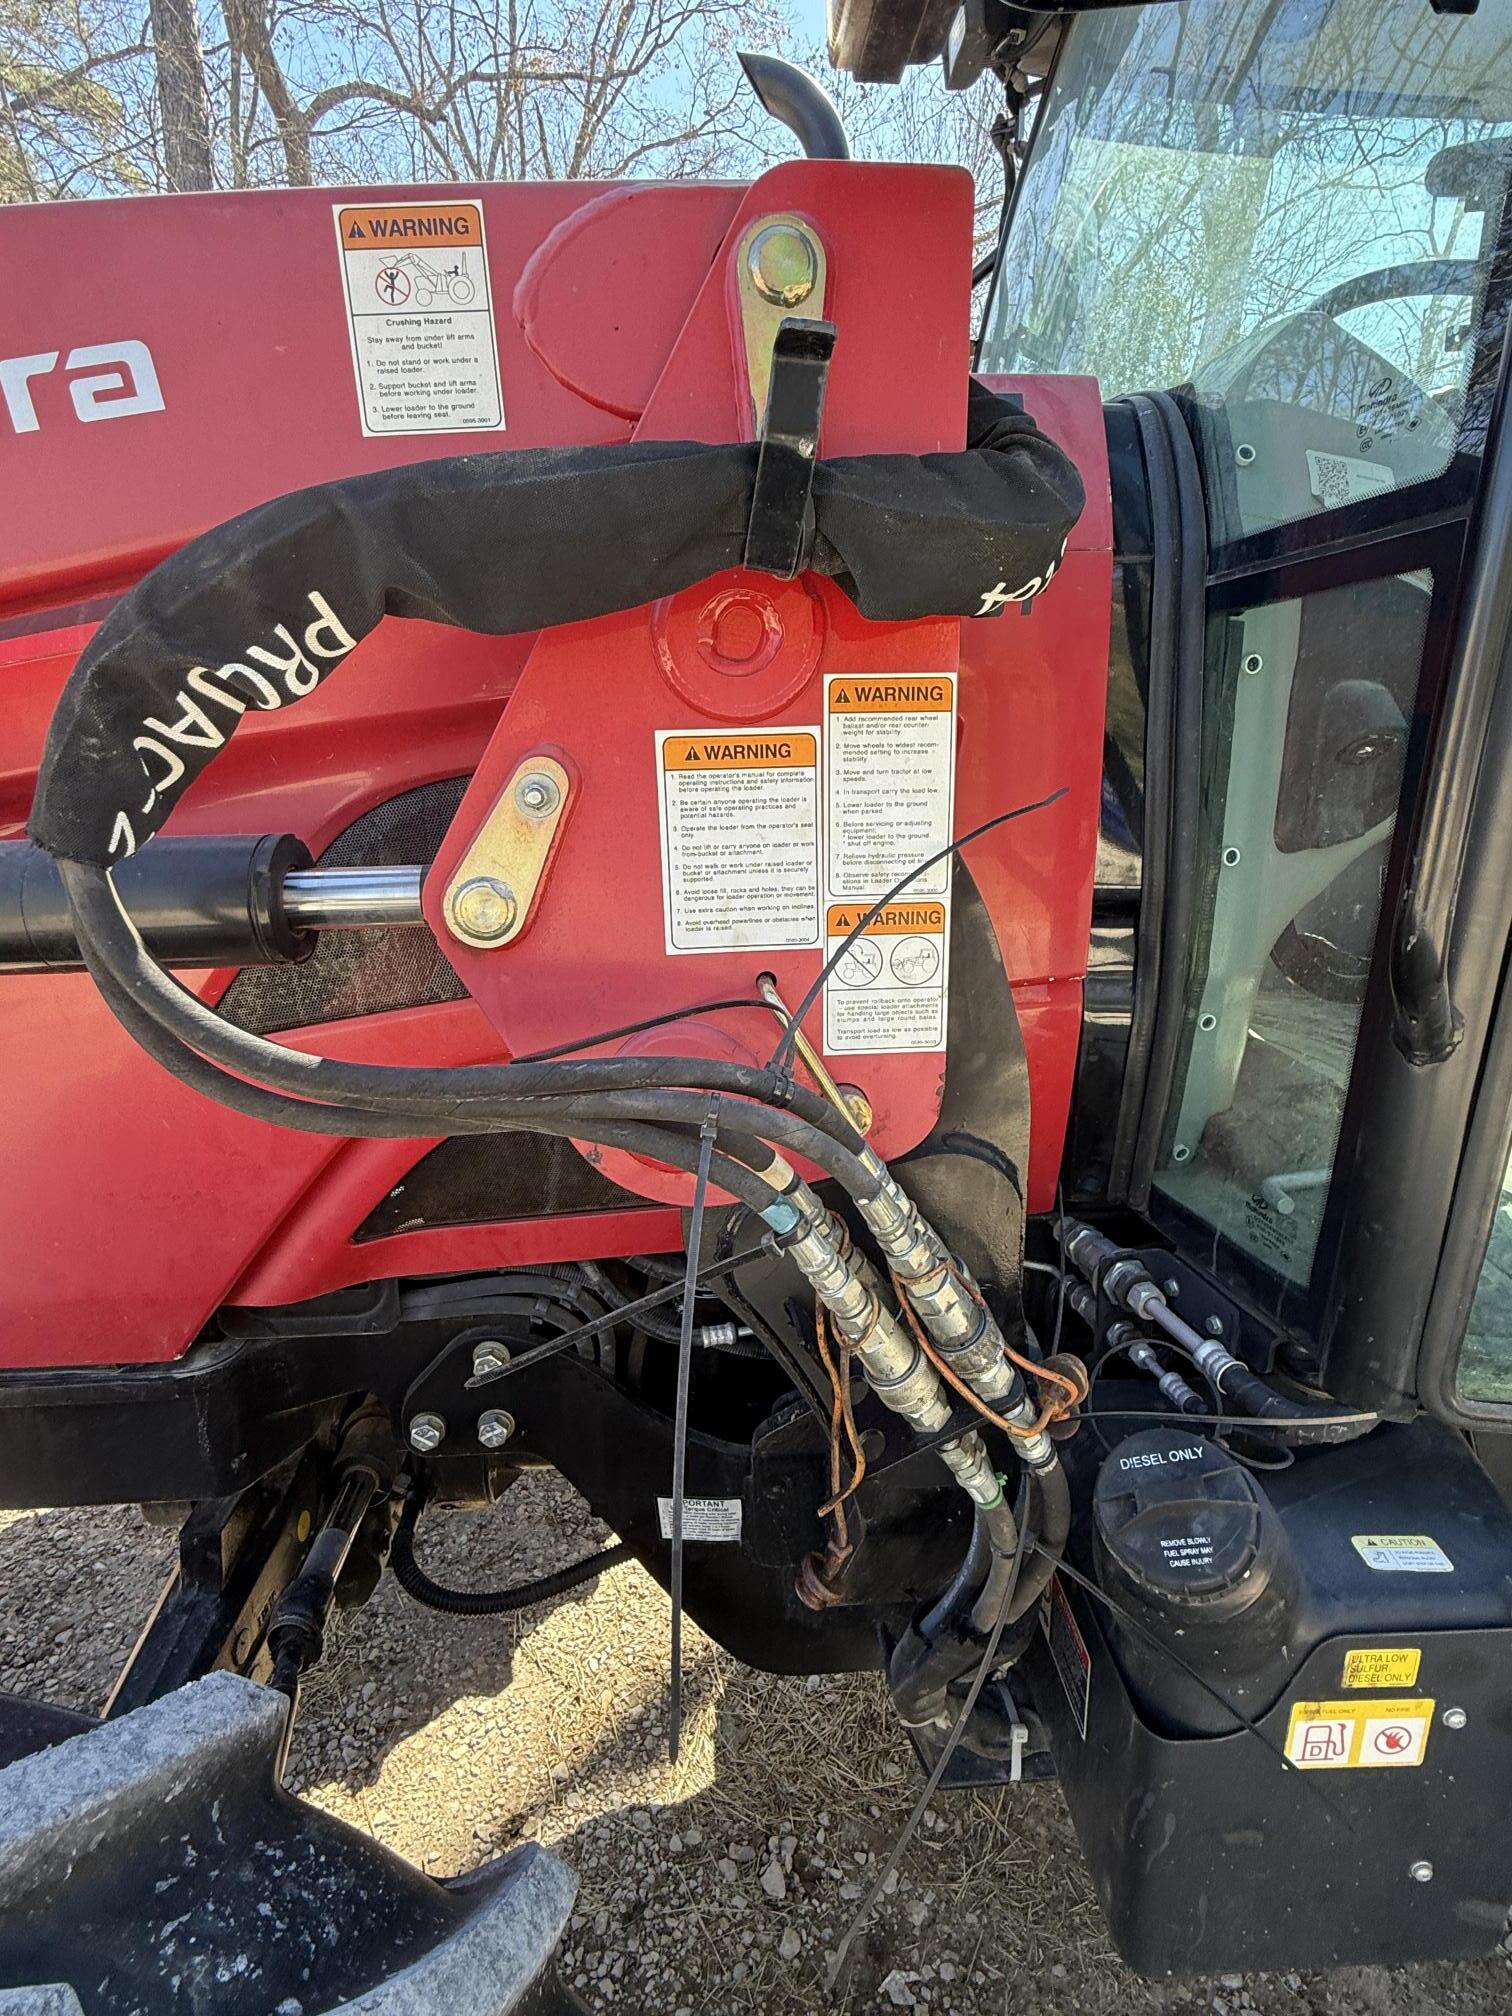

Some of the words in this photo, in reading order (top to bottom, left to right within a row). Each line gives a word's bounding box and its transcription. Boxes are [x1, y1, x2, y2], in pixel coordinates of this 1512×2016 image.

[368, 217, 470, 238] WARNING
[385, 317, 421, 328] Crushing
[423, 316, 452, 324] Hazard
[367, 336, 382, 345] Stay
[405, 334, 421, 342] from
[423, 333, 444, 341] under
[401, 342, 414, 350] and
[416, 341, 442, 349] bucket!
[376, 366, 398, 374] raised
[400, 365, 424, 373] loader.
[378, 382, 406, 391] Support
[379, 389, 401, 397] before
[403, 388, 430, 397] working
[450, 401, 475, 410] ground
[406, 411, 431, 420] leaving
[855, 686, 943, 702] WARNING
[704, 743, 791, 760] WARNING
[1120, 1453, 1167, 1470] DIESEL
[1168, 1446, 1204, 1462] ONLY
[1160, 1538, 1187, 1547] REMOVE
[1380, 1538, 1427, 1546] CAUTION
[1163, 1548, 1180, 1557] FUEL
[1180, 1548, 1200, 1557] SPRAY
[1200, 1546, 1214, 1555] MAY
[1169, 1558, 1191, 1567] CAUSE
[1191, 1557, 1213, 1566] INJURY
[1351, 1654, 1384, 1664] ULTRA
[1385, 1653, 1409, 1663] LOW
[1349, 1664, 1389, 1674] SULFUR
[1348, 1674, 1383, 1684] DIESEL
[1384, 1673, 1412, 1682] ONLY
